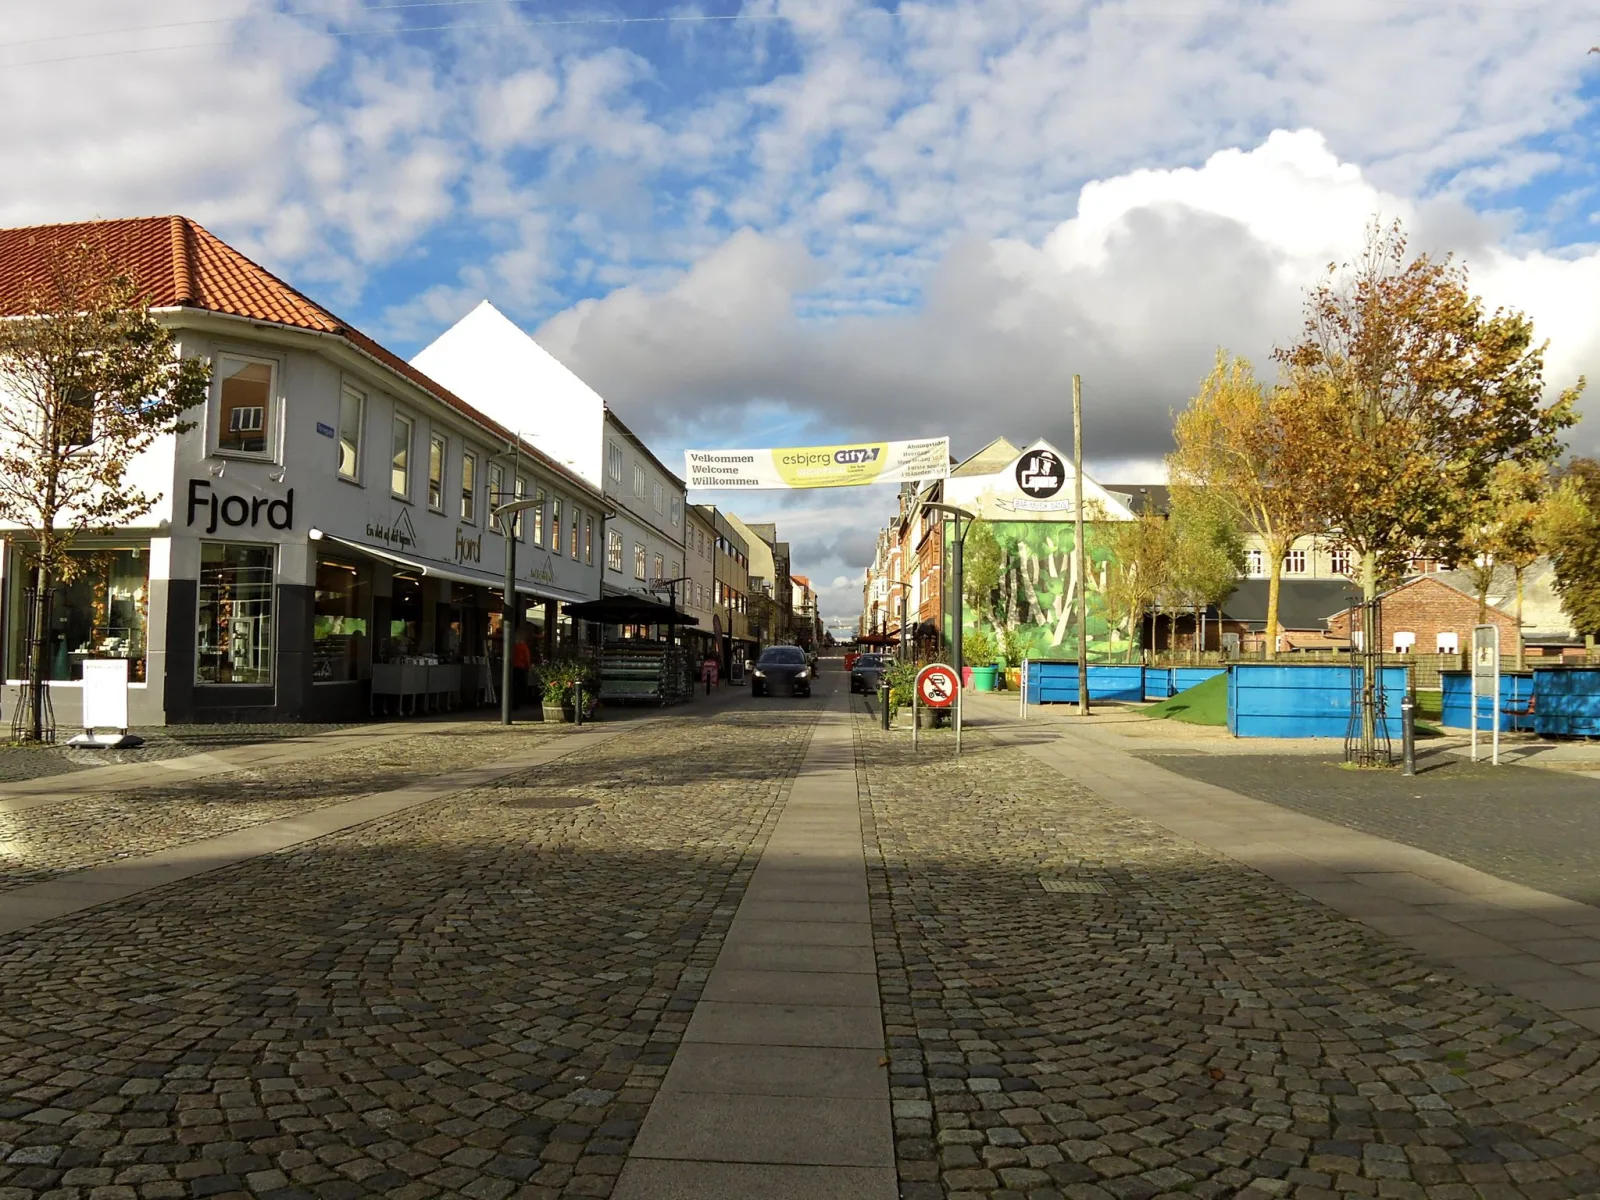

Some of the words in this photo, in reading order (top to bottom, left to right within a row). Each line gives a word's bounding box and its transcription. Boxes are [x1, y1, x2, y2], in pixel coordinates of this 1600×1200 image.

[690, 453, 754, 463] Velkommen
[782, 452, 831, 467] esbjerg
[691, 465, 739, 475] Welcome
[691, 477, 759, 486] Willkommen
[187, 478, 294, 534] Fjord
[455, 527, 482, 564] Fjord
